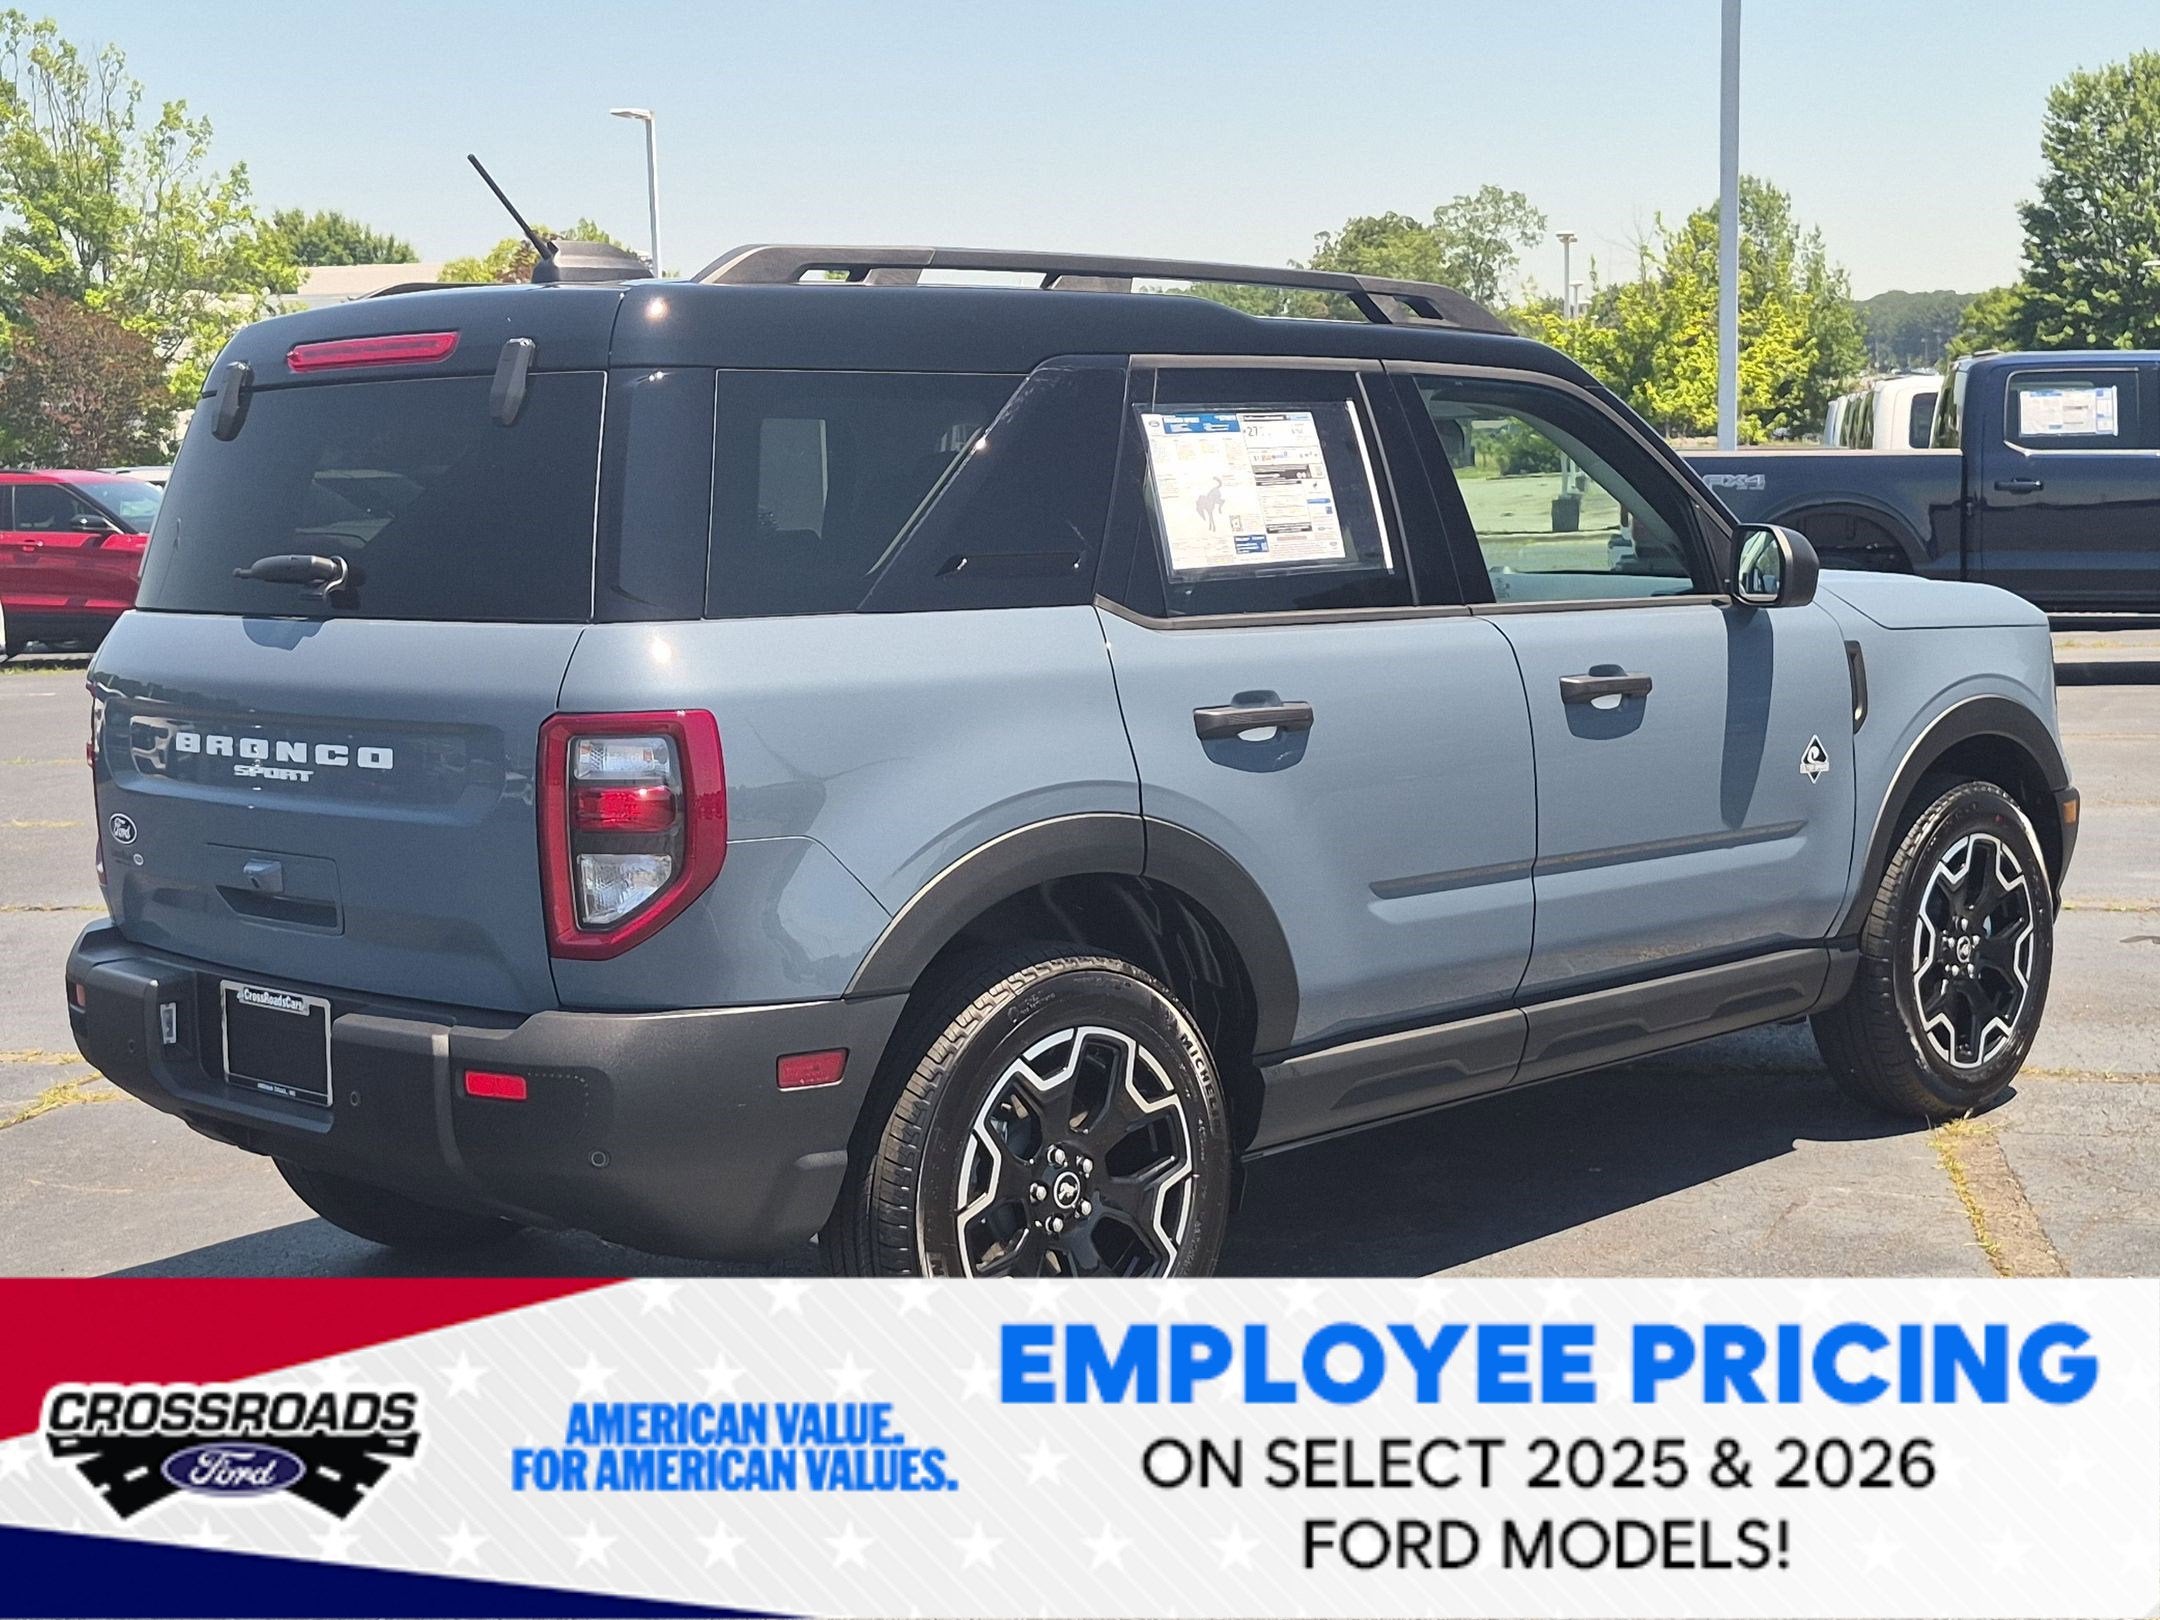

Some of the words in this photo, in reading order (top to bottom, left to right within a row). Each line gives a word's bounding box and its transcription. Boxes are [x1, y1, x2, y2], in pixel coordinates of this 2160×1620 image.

[1702, 474, 1766, 491] FX4
[175, 732, 394, 770] BRONCO
[233, 764, 314, 782] SPORT
